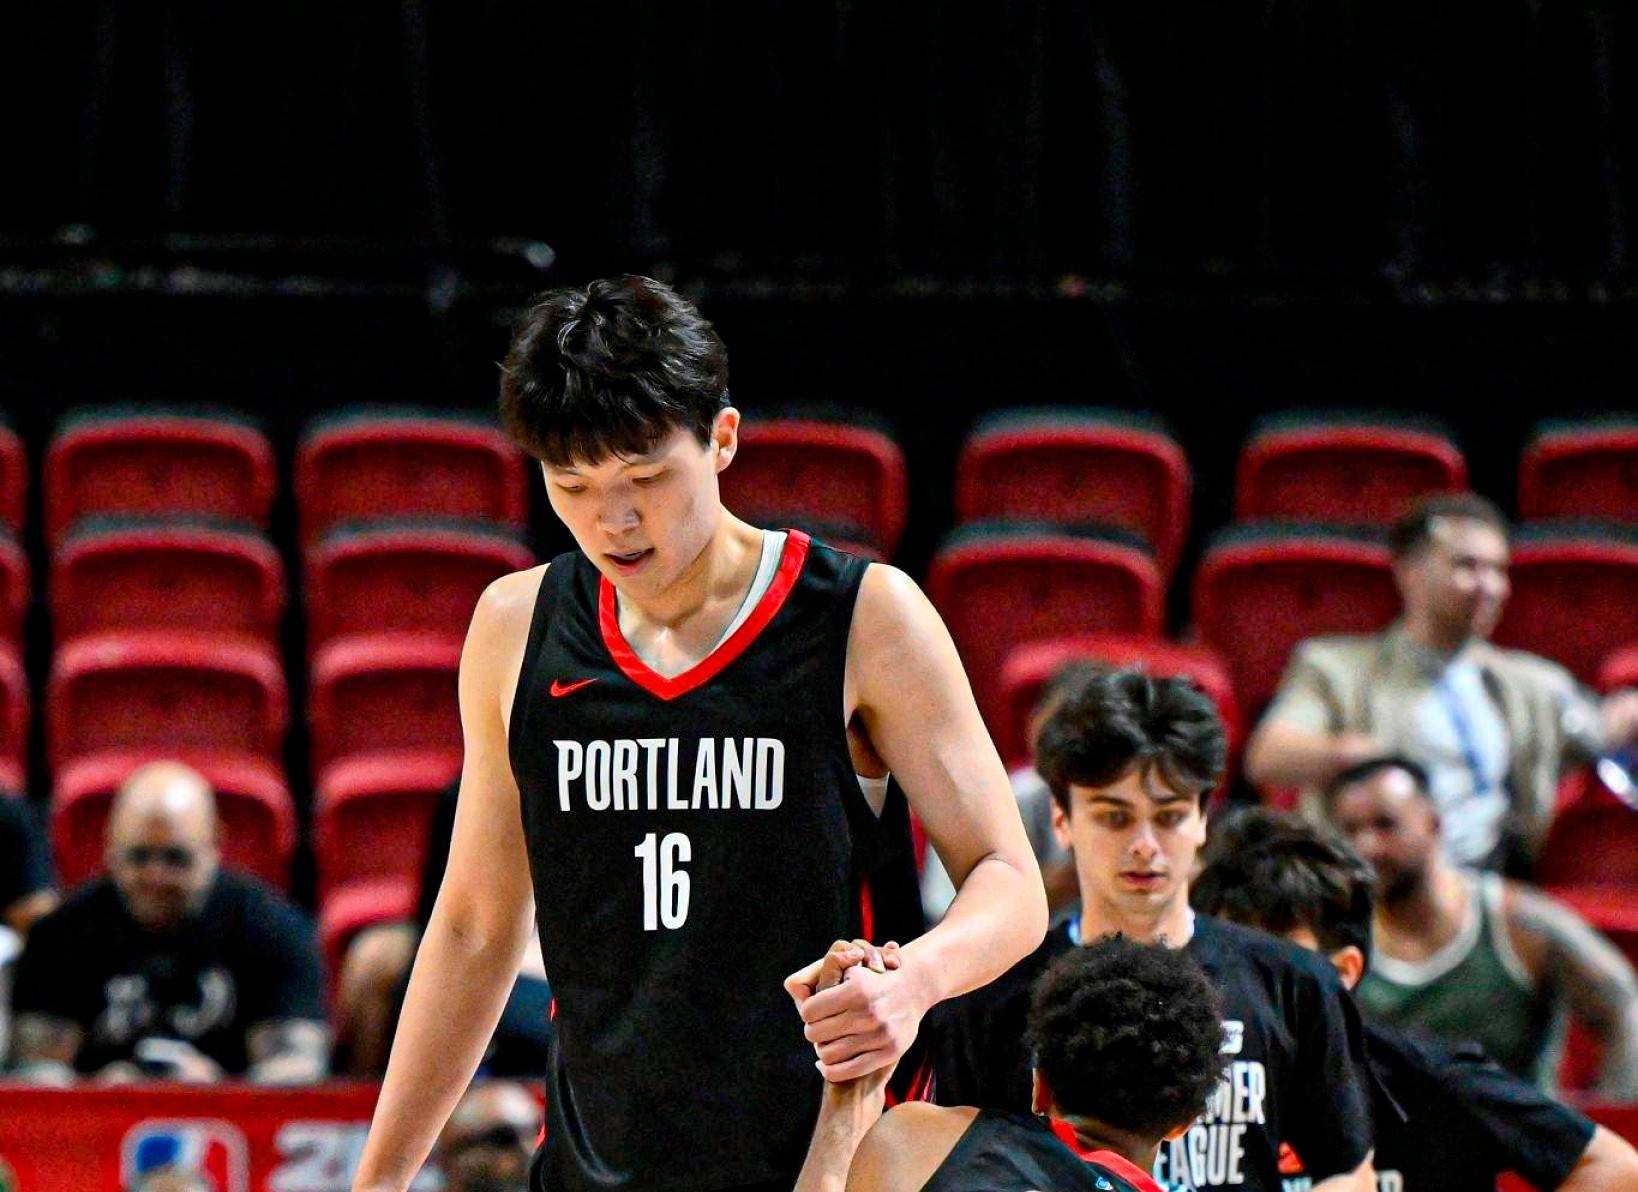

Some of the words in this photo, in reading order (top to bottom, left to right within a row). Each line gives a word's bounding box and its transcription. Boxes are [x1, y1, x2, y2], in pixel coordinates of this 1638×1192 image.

[552, 737, 785, 812] PORTLAND
[634, 832, 692, 931] 16
[1205, 1060, 1266, 1125] MER
[1153, 1122, 1248, 1192] EAGUE
